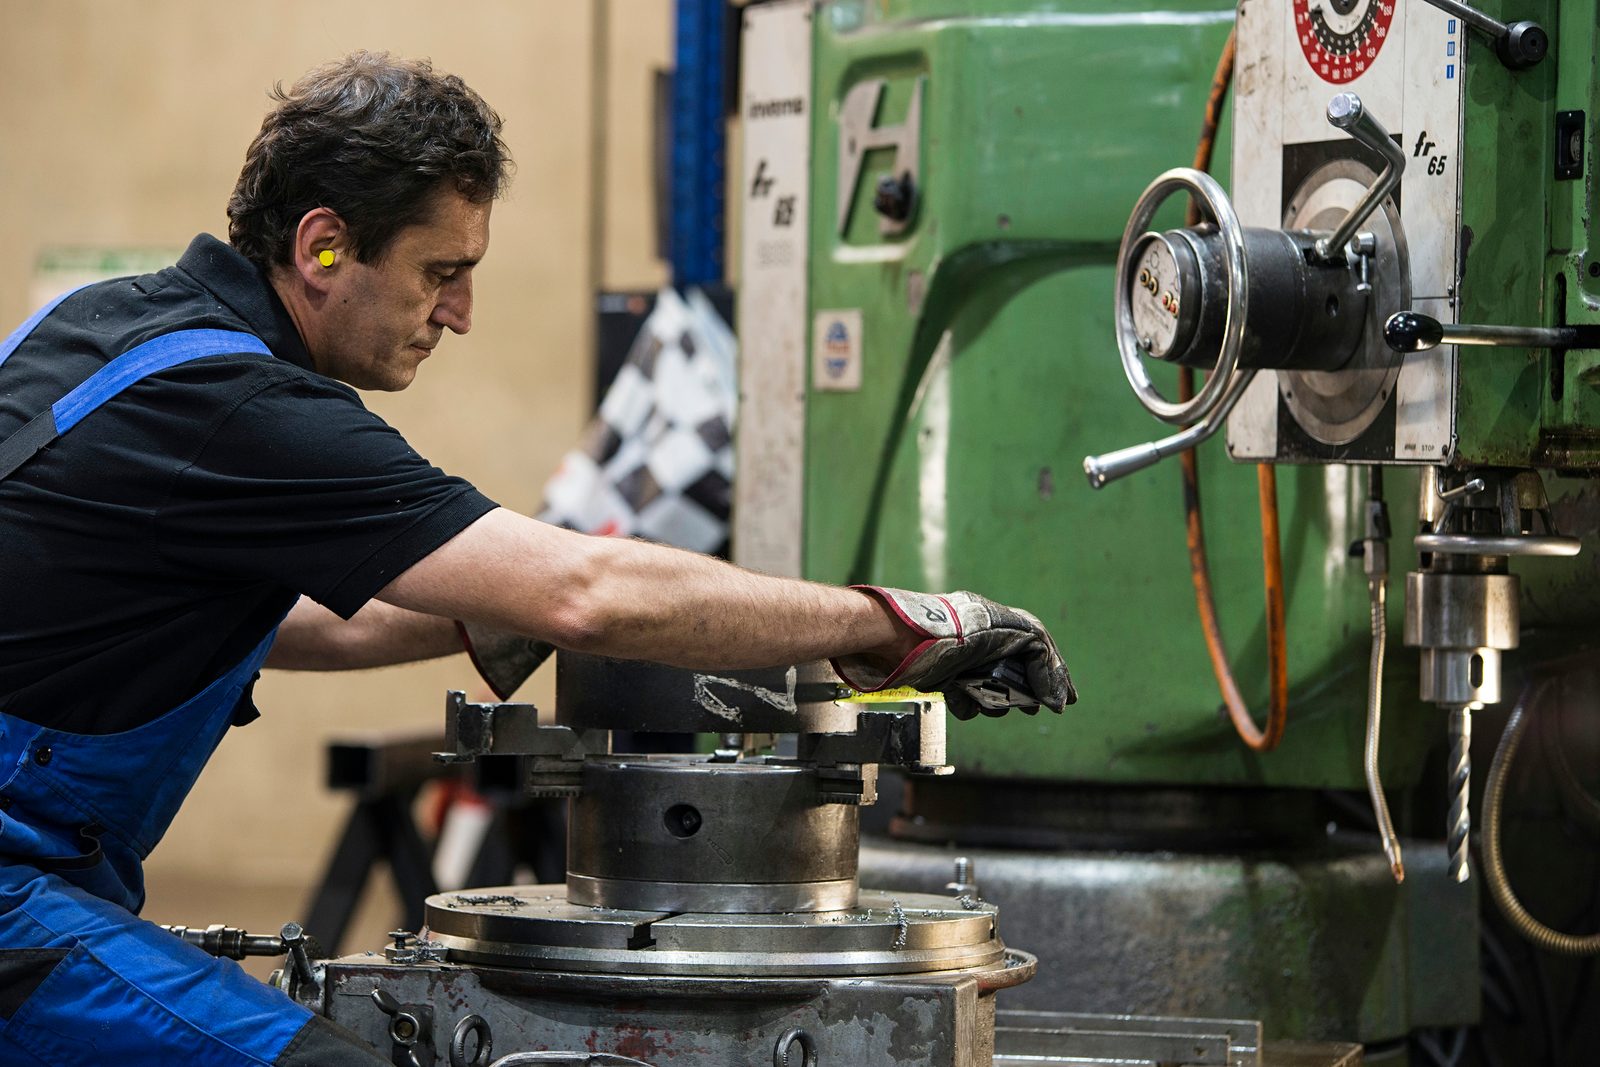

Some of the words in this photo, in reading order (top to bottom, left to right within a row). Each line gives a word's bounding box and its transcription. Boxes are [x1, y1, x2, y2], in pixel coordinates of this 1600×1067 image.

[1413, 130, 1436, 157] fr
[750, 158, 775, 197] fr
[1428, 156, 1447, 176] 65
[1421, 444, 1435, 452] STOP
